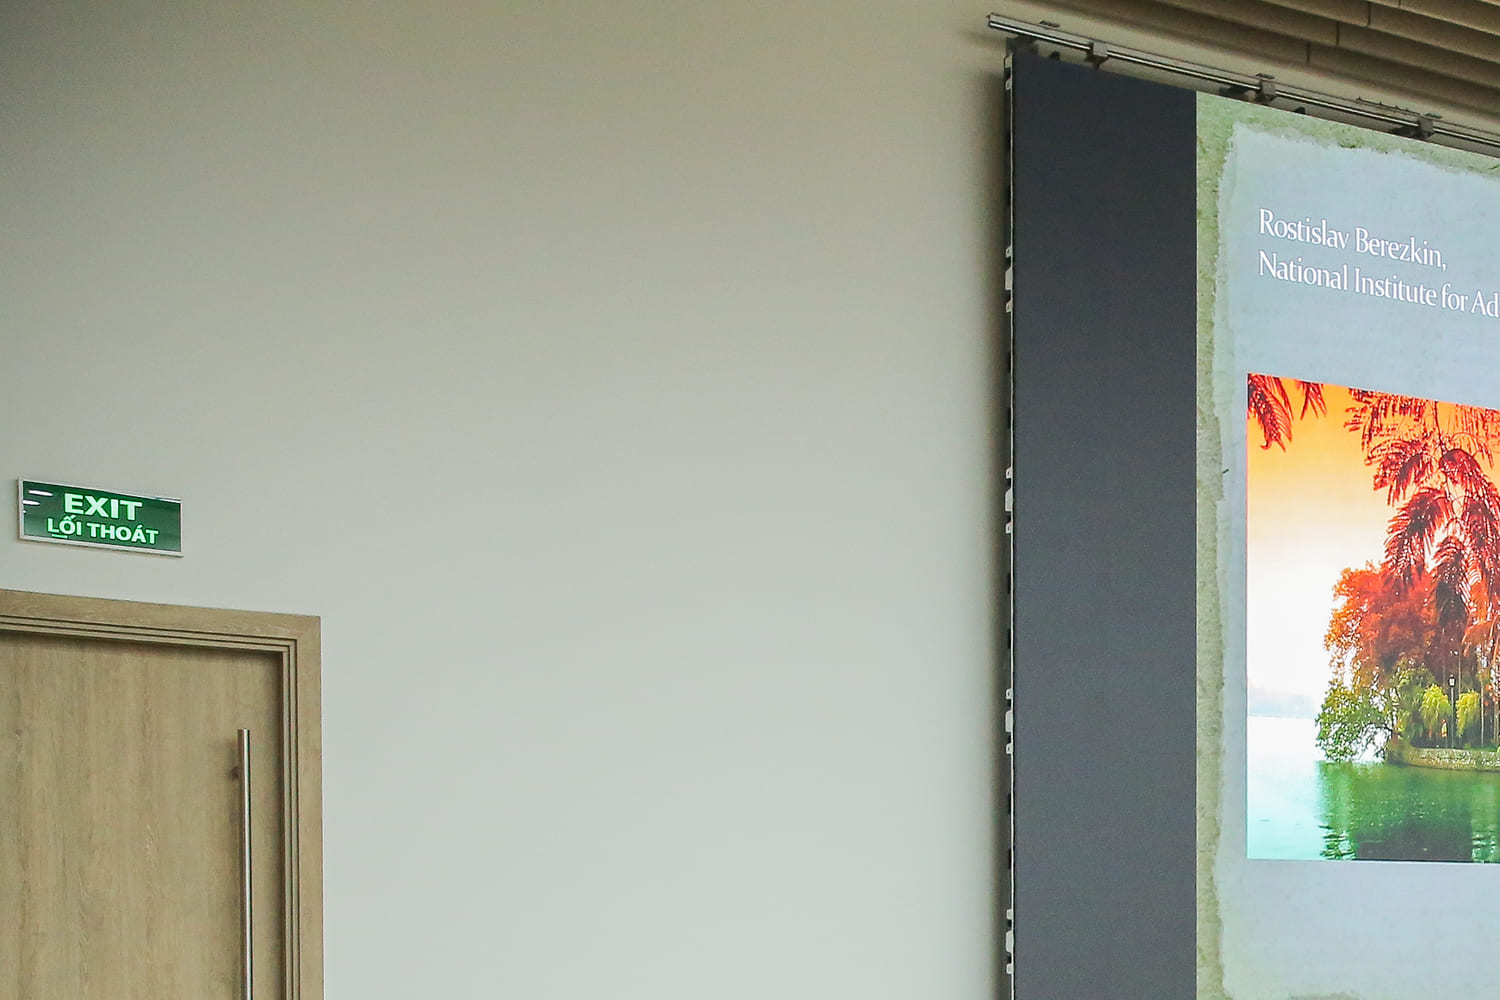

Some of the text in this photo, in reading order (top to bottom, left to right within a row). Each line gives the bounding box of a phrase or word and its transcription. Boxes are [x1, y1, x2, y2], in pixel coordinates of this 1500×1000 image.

[1258, 208, 1448, 271] Rostislav Berezkin,
[1258, 250, 1349, 291] National
[1353, 267, 1438, 308] Institute
[1440, 282, 1469, 312] for
[64, 492, 143, 521] EXIT
[47, 515, 159, 545] LỐI THOÁT
